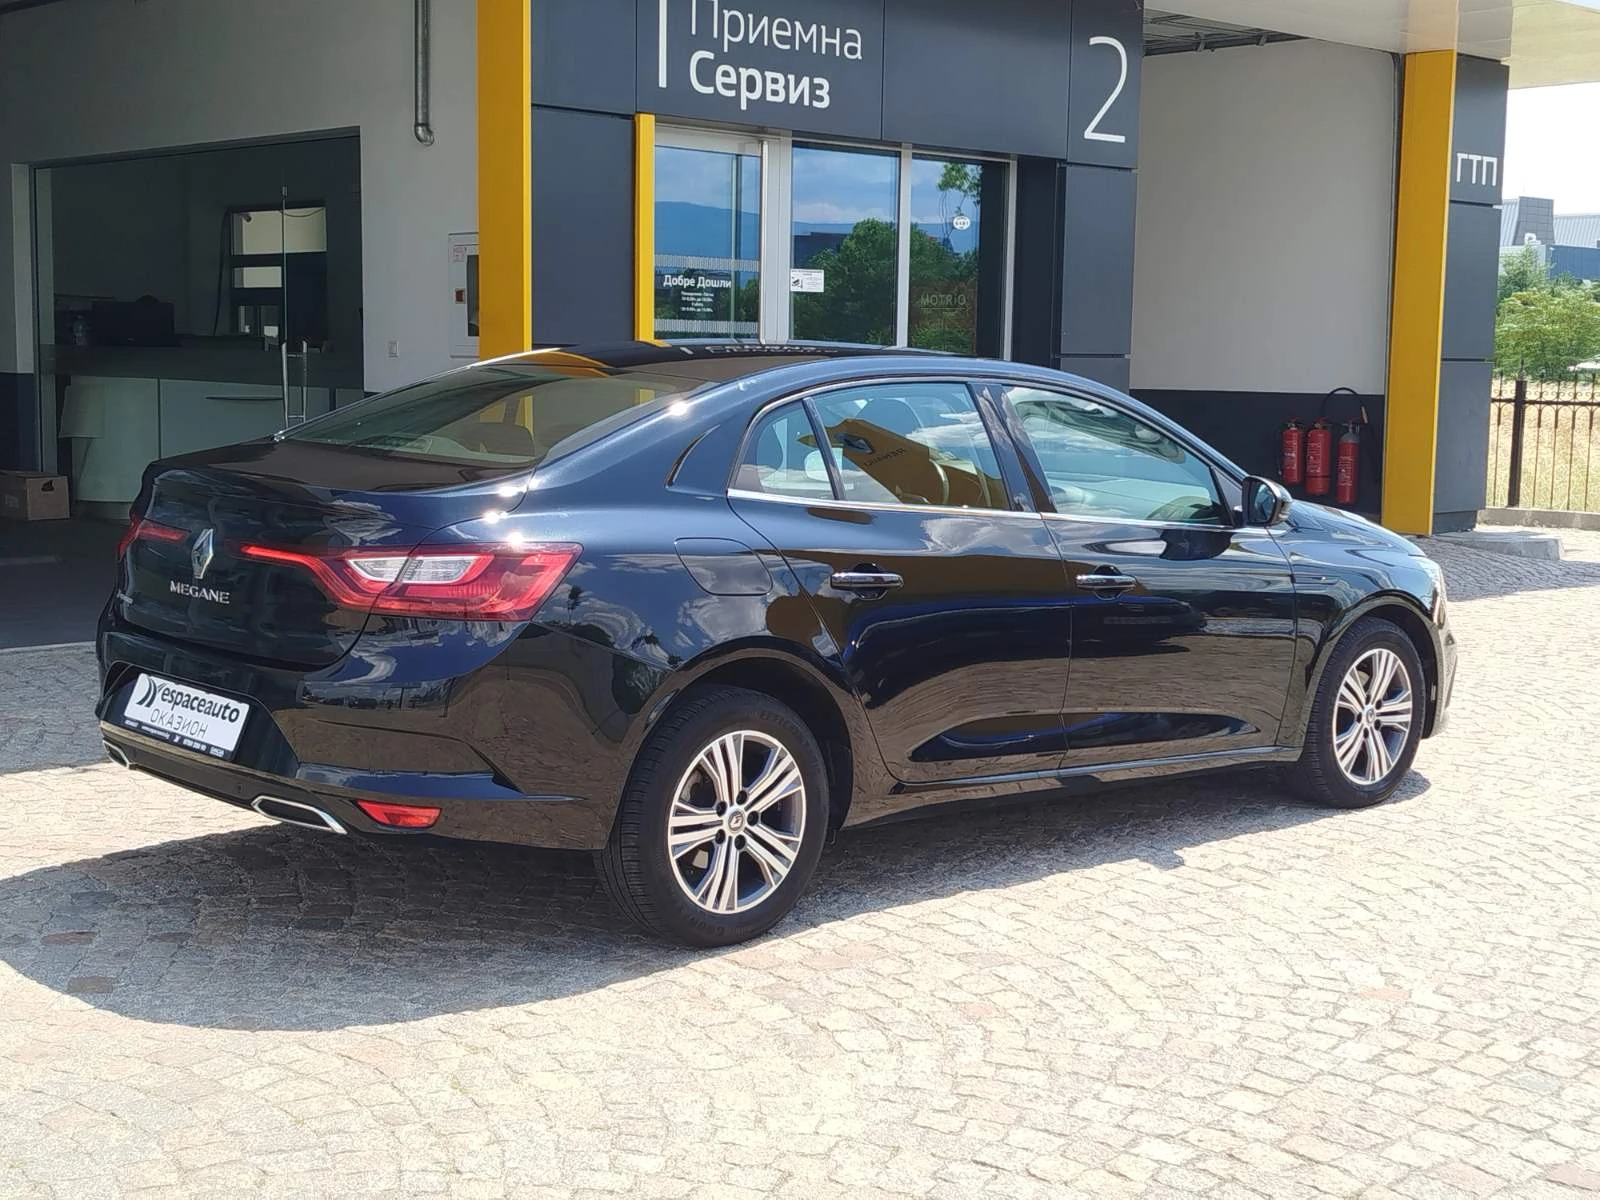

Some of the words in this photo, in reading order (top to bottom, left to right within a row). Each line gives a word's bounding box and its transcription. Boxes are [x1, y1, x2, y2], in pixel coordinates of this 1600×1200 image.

[691, 0, 863, 60] Приемна
[689, 49, 831, 110] Сервиз
[1083, 35, 1128, 143] 2
[1456, 152, 1498, 187] ГТП
[663, 275, 696, 288] Добре
[697, 277, 732, 288] Дошли
[169, 580, 230, 605] MEGANE
[160, 687, 240, 723] espaceauto
[150, 708, 208, 740] ОКАЗИОН
